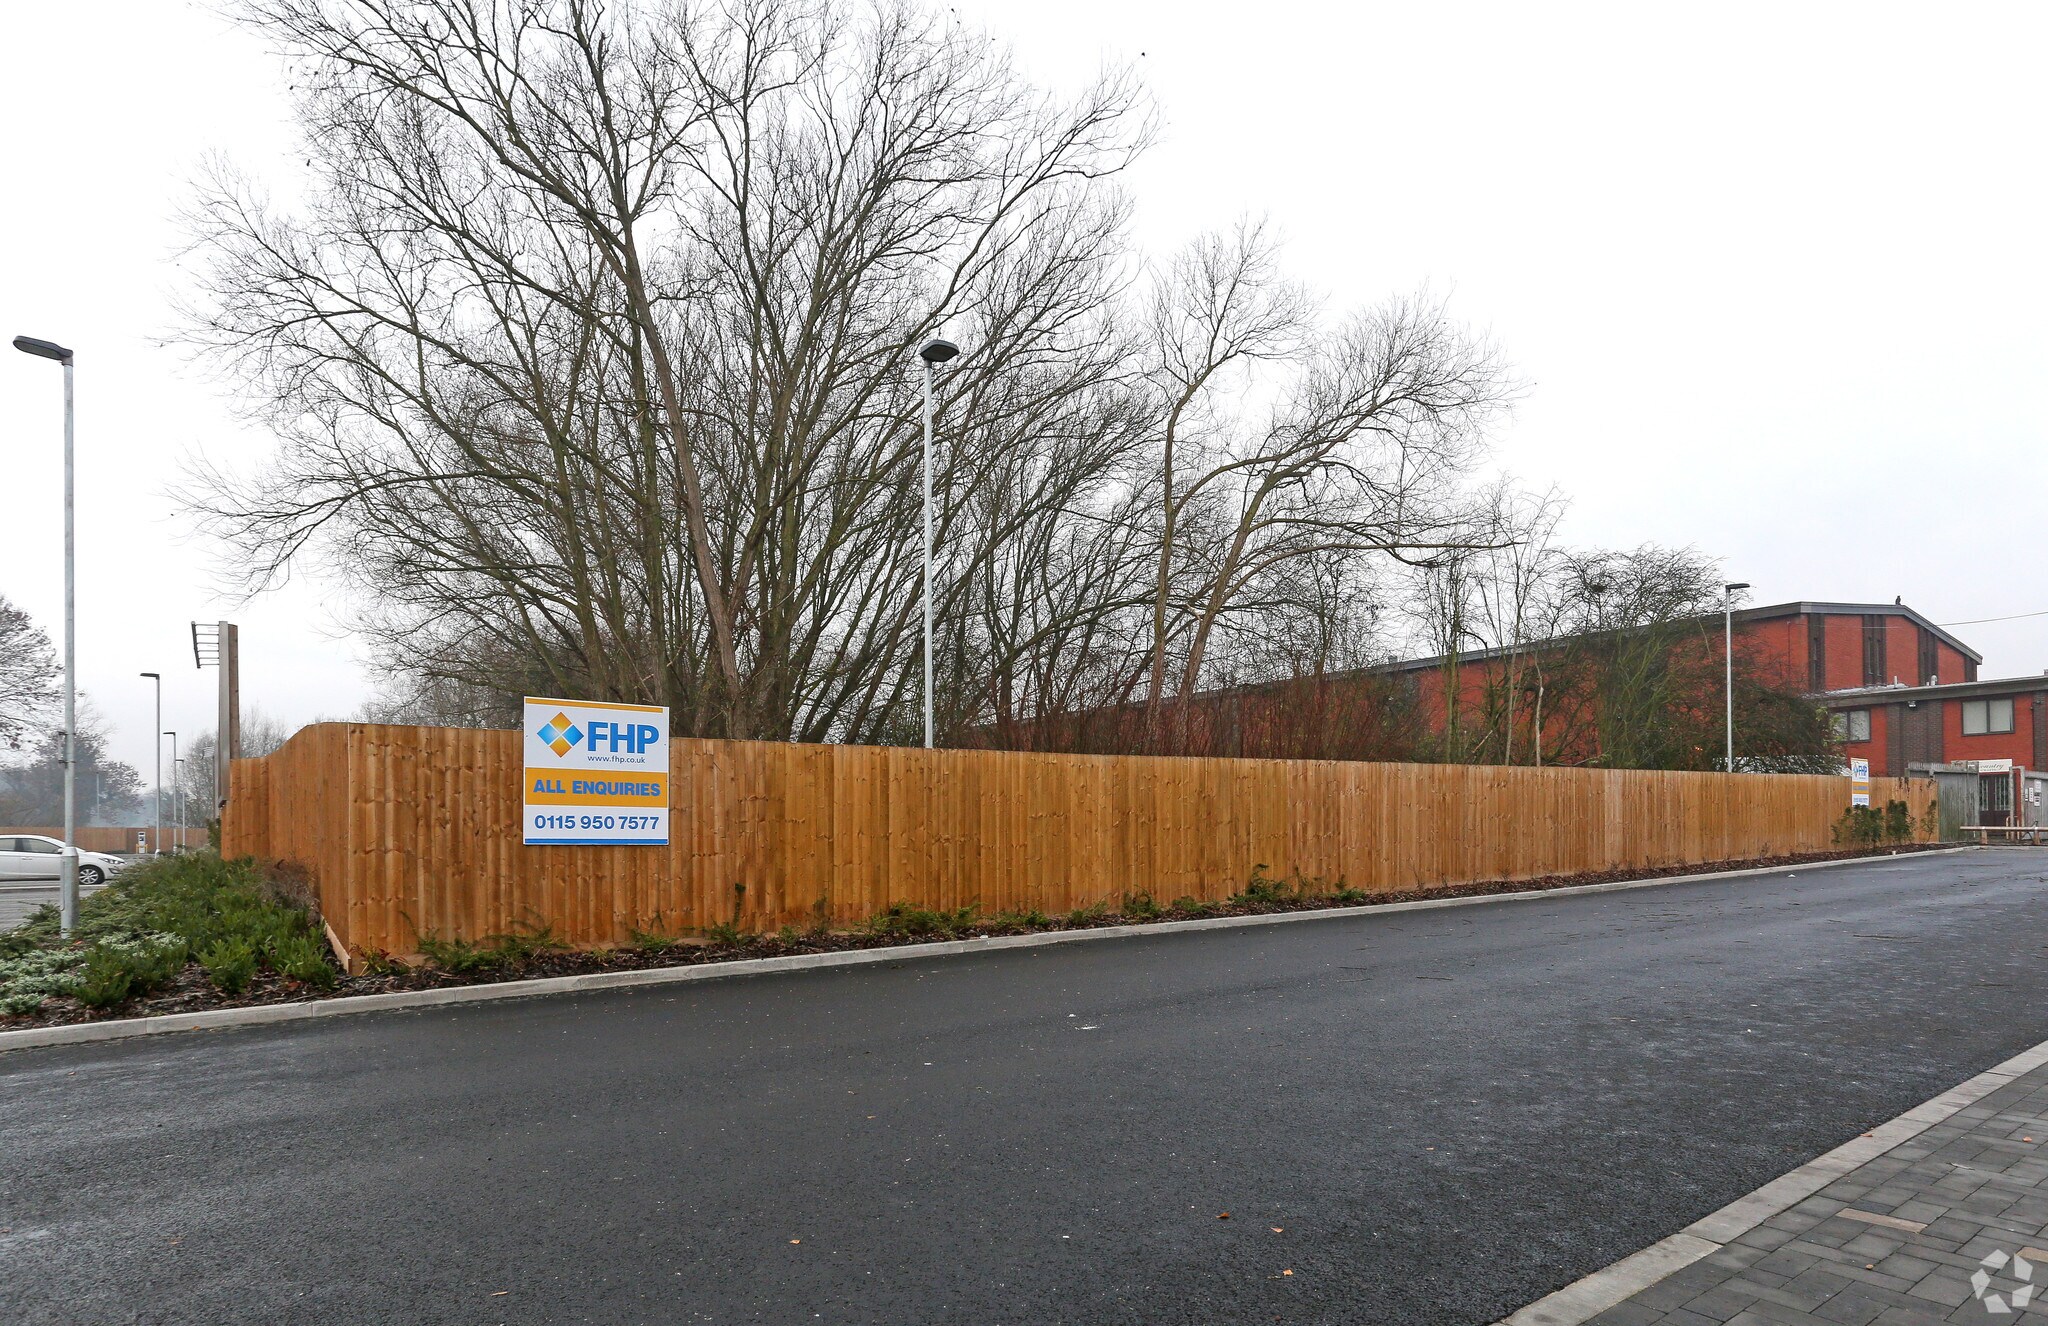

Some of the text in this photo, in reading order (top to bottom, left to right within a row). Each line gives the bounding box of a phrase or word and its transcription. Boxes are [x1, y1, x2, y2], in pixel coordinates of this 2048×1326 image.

[587, 721, 660, 754] FHP
[587, 755, 646, 764] www.fhp.co.uk
[533, 780, 661, 797] ALL ENQUIRIES
[534, 815, 660, 830] 0115 950 7577
